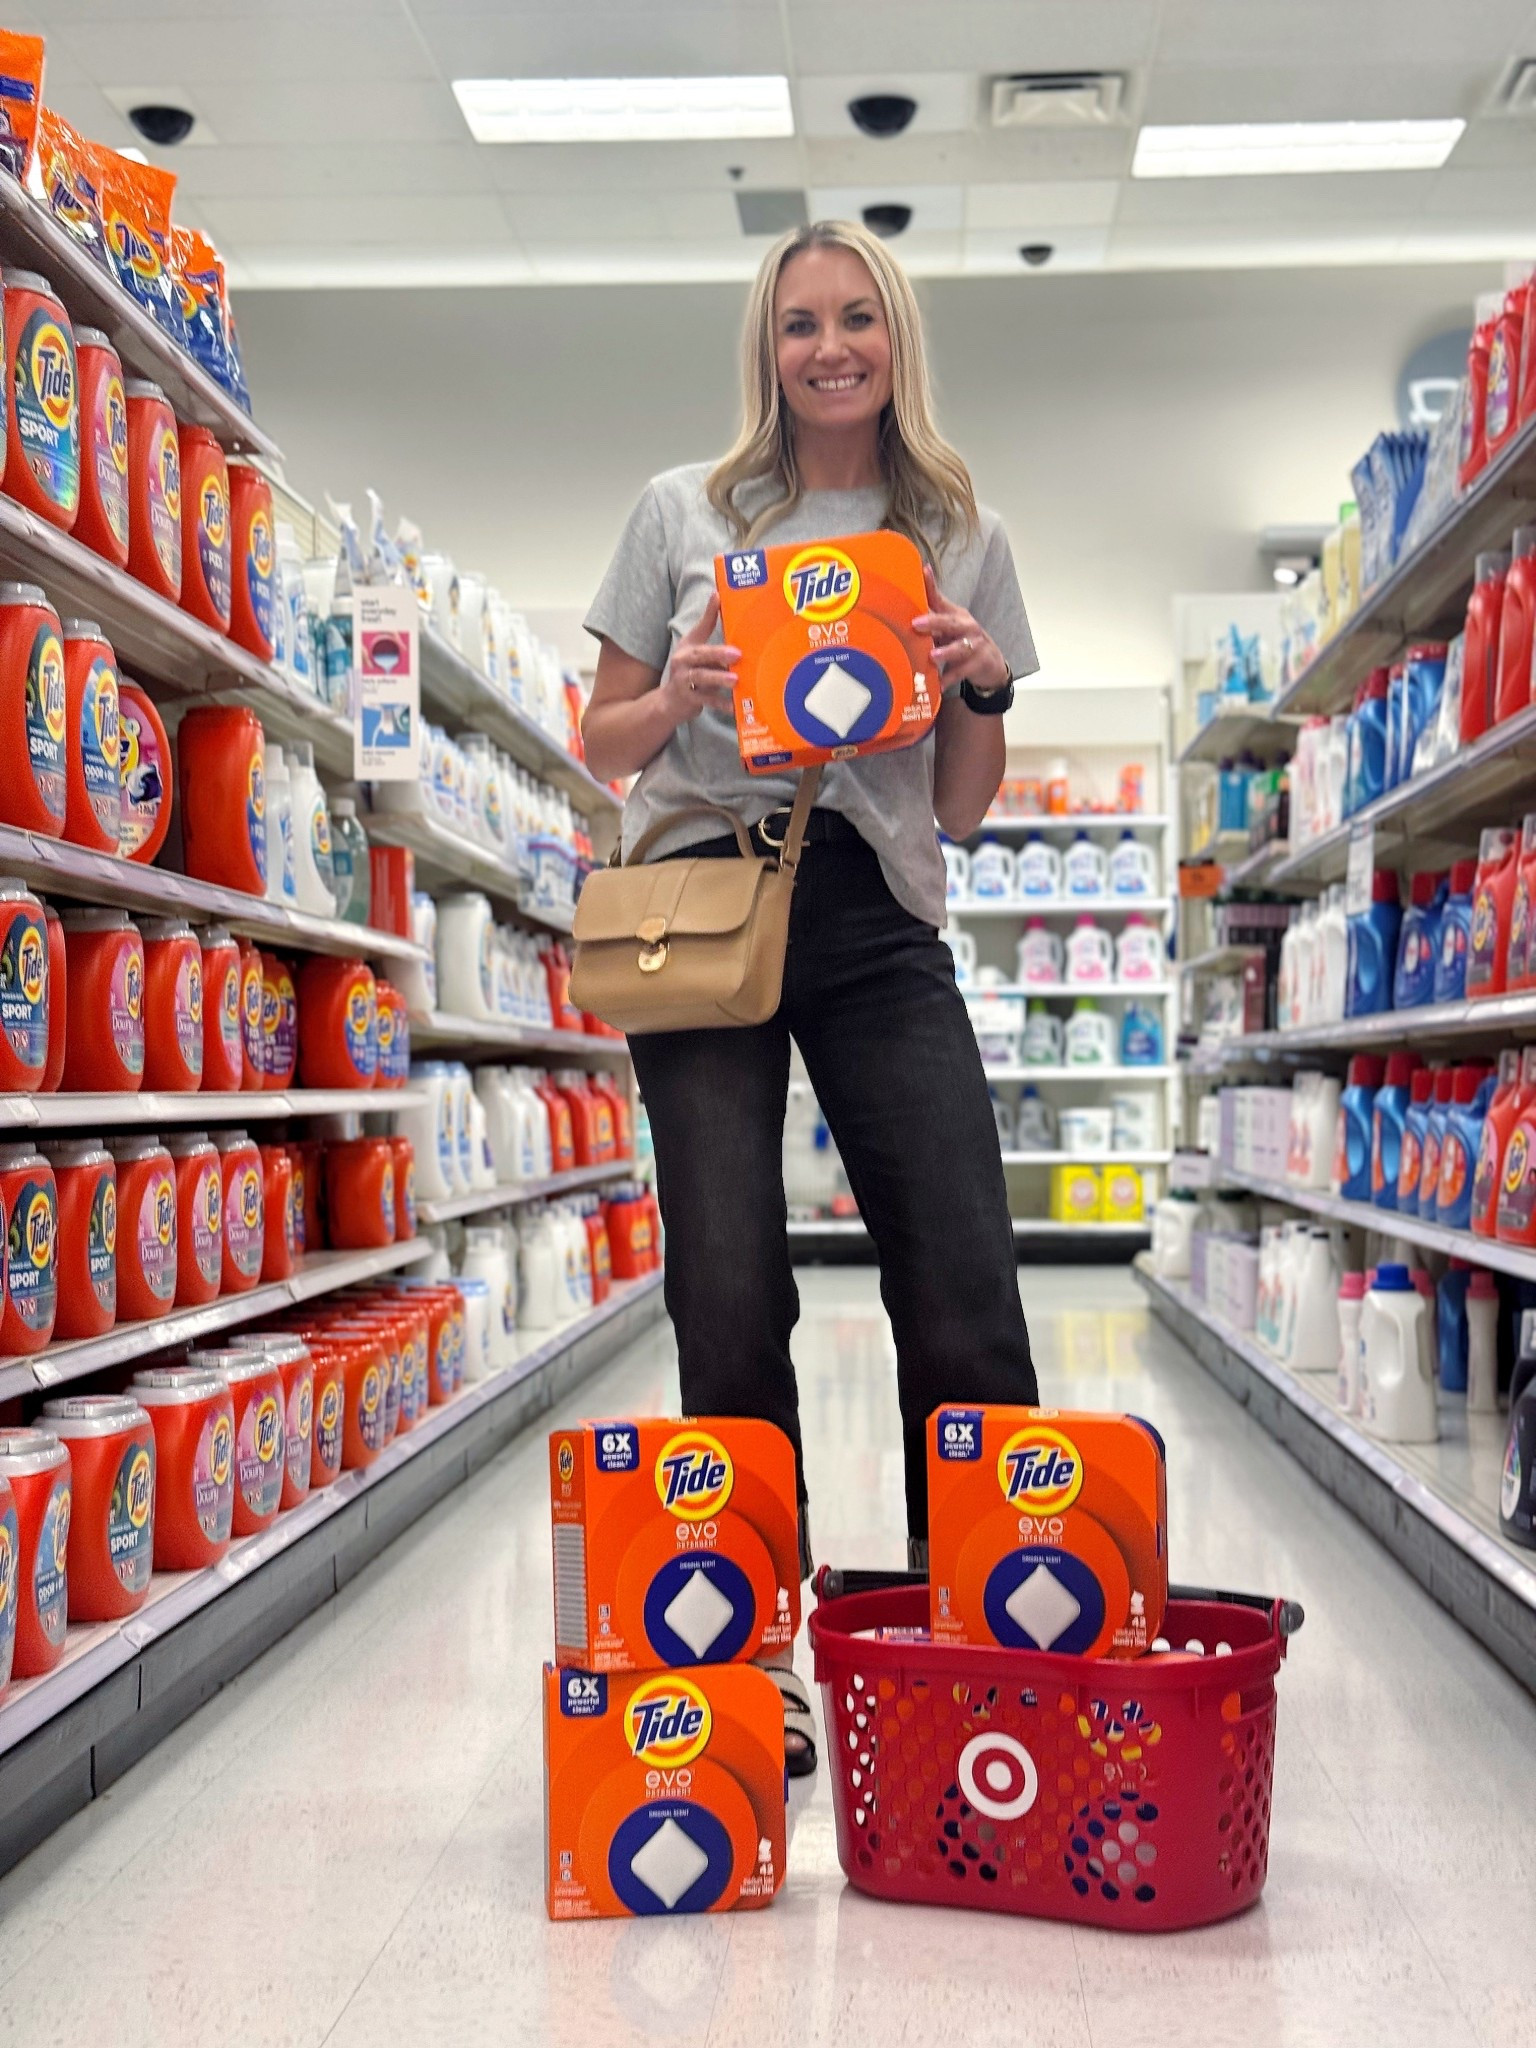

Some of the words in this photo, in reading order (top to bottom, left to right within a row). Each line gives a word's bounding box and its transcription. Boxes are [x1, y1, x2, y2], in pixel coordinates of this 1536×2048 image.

[38, 347, 72, 402] Tide
[19, 418, 59, 449] SPORT
[205, 492, 224, 528] Tide
[731, 554, 760, 574] 6X
[790, 561, 853, 615] Tide
[808, 620, 849, 641] evo
[30, 736, 59, 761] SPORT
[22, 946, 44, 988] Tide
[2, 1003, 33, 1021] SPORT
[112, 1012, 134, 1037] Downy
[31, 1210, 51, 1256] Tide
[142, 1241, 164, 1263] Downy
[90, 1255, 111, 1274] SPORT
[9, 1271, 40, 1291] SPORT
[602, 1433, 632, 1454] 6X
[944, 1422, 974, 1443] 6X
[240, 1463, 265, 1482] Downy
[662, 1450, 727, 1510] Tide
[1006, 1447, 1075, 1502] Tide
[196, 1484, 219, 1505] Downy
[676, 1520, 718, 1542] evo
[1018, 1516, 1064, 1537] evo
[110, 1530, 139, 1555] SPORT
[567, 1677, 599, 1698] 6X
[632, 1695, 704, 1757] Tide
[645, 1768, 692, 1789] evo
